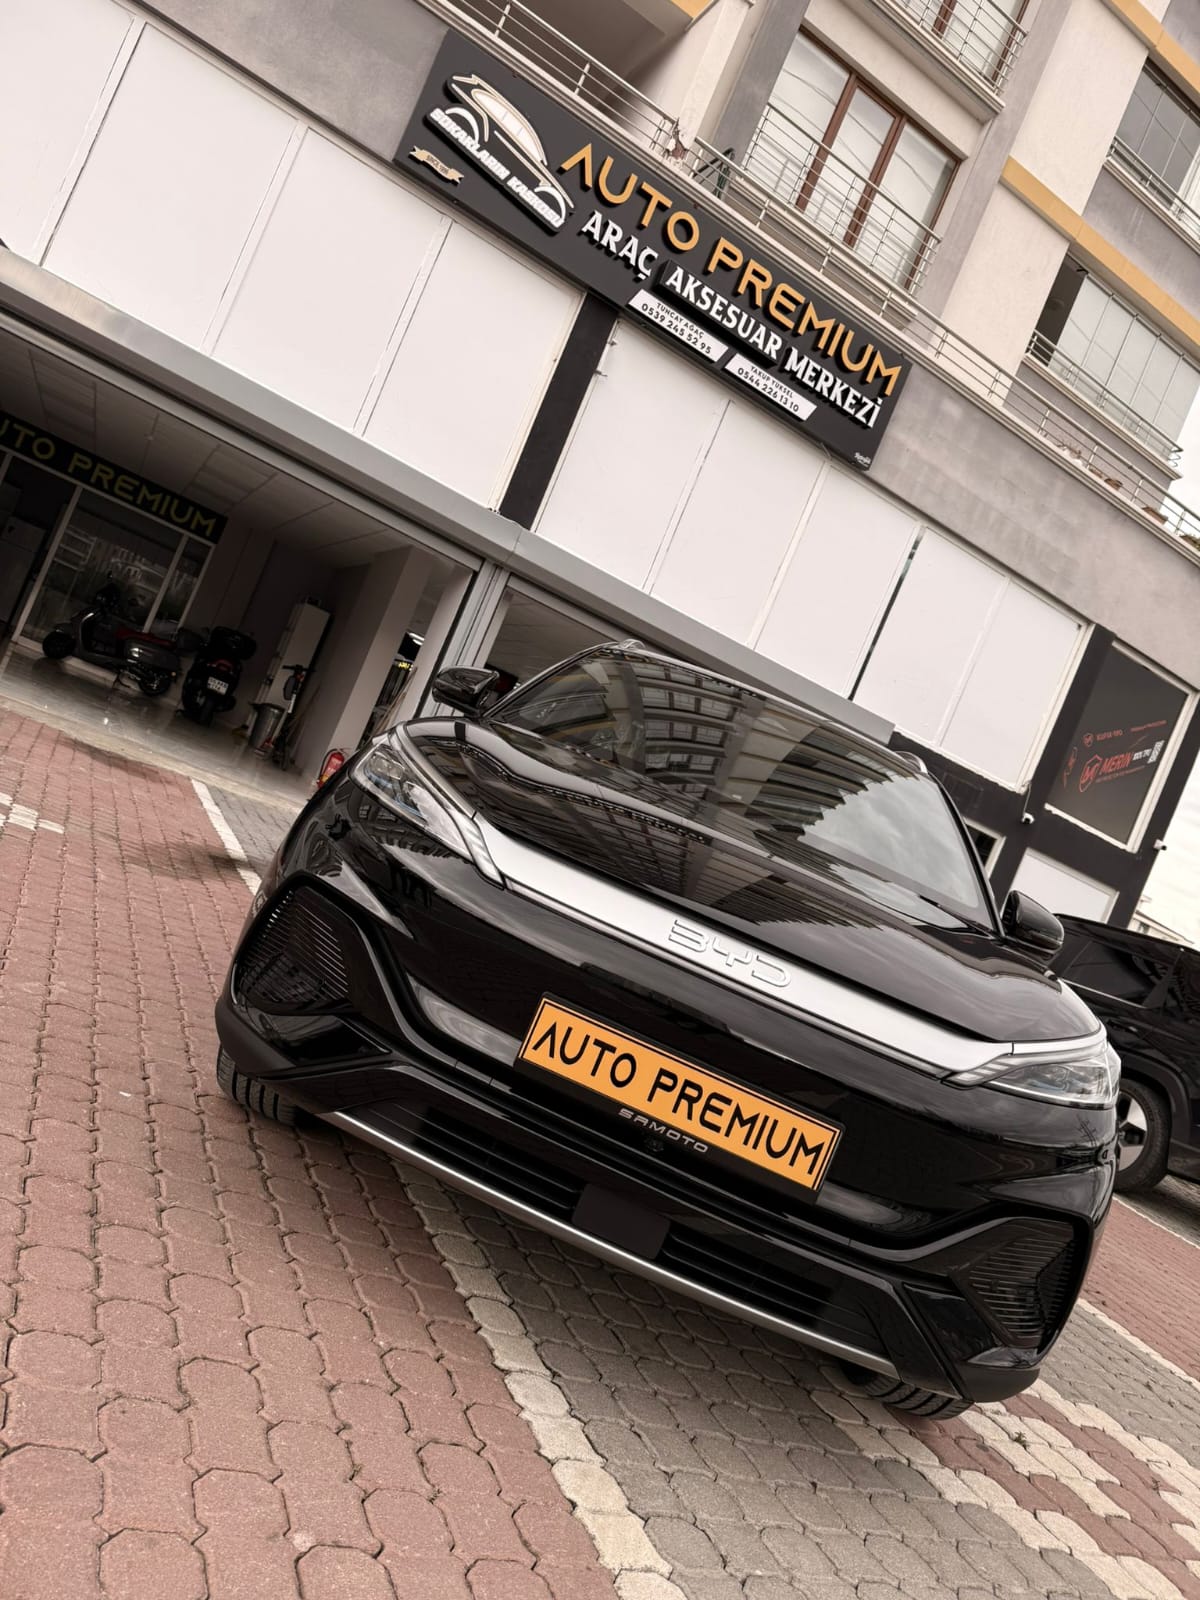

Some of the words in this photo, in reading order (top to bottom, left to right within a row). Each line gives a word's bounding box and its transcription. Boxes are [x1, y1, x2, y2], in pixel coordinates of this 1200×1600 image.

[561, 143, 700, 251] AUTO
[707, 237, 902, 396] PREMIUM
[581, 210, 659, 280] ARAÇ
[665, 265, 783, 360] AKSESUAR
[784, 346, 884, 428] MERKEZİ
[641, 303, 666, 323] 0539
[666, 320, 685, 337] 245
[686, 333, 698, 346] 52
[699, 342, 712, 354] 95
[656, 302, 684, 323] TUNCAY
[737, 367, 760, 387] 0544
[761, 383, 778, 399] 226
[779, 394, 788, 406] 13
[789, 401, 799, 412] 10
[750, 365, 771, 382] YAKUP
[67, 452, 217, 537] PREMIUM
[668, 919, 792, 988] BYD
[531, 1021, 638, 1088] AUTO
[646, 1067, 826, 1176] PREMIUM
[618, 1107, 709, 1153] SAMOTO
